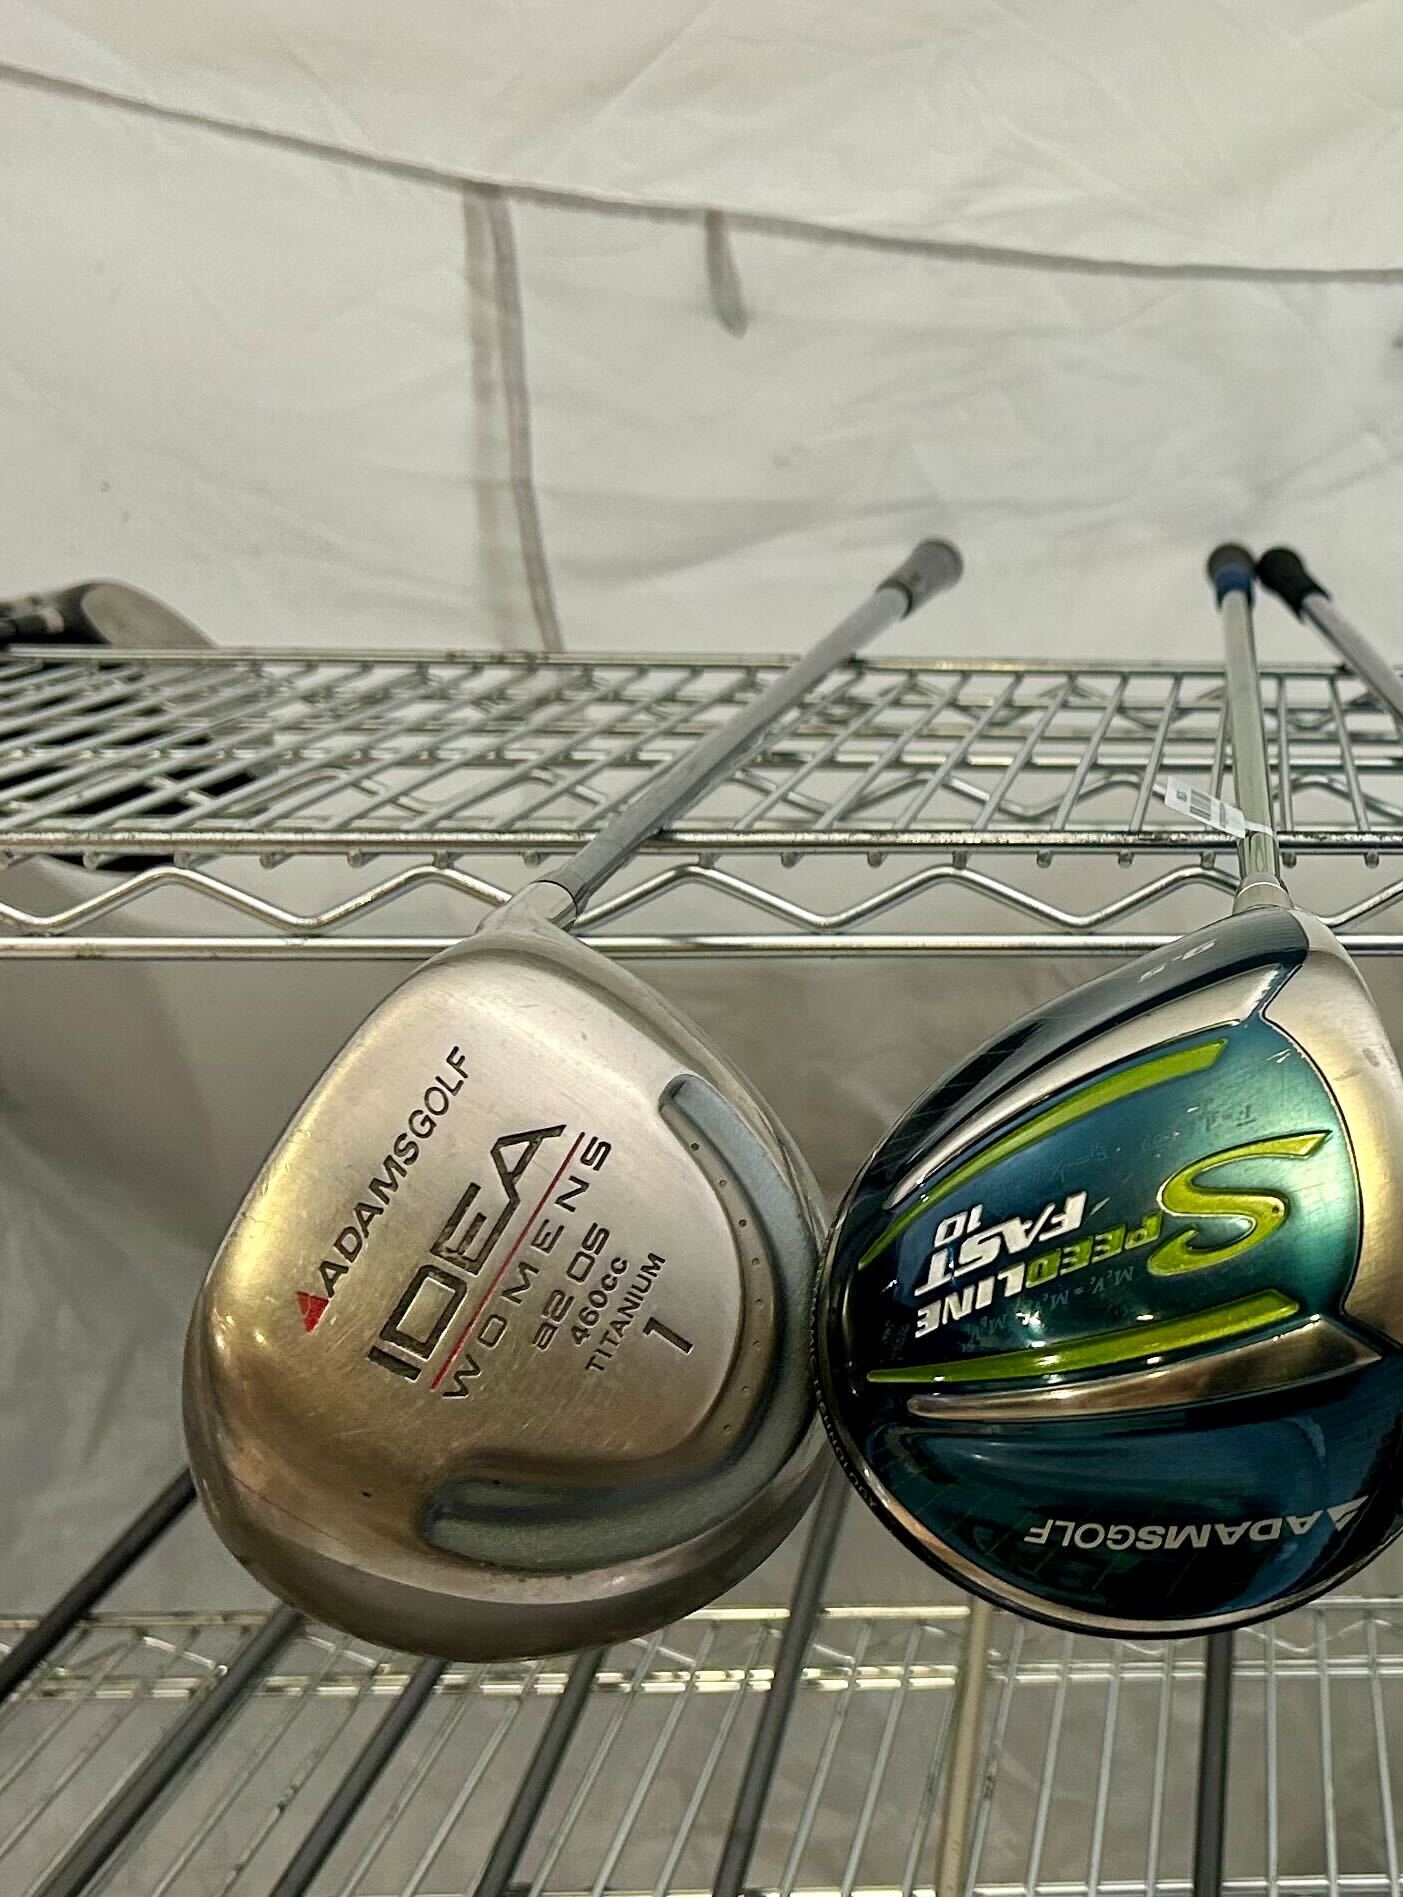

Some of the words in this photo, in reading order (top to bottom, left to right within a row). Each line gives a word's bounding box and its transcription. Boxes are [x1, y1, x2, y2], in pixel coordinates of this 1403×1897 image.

[320, 1046, 471, 1299] ADAMSGOLF
[933, 1203, 984, 1249] 10
[368, 1124, 567, 1380] IDEA
[442, 1136, 612, 1399] WOMENS
[914, 1130, 1333, 1338] SPEEDLINE
[914, 1190, 1088, 1297] FAST
[569, 1256, 630, 1346] 460cc
[584, 1252, 666, 1372] TITANIUM
[642, 1316, 694, 1355] 1
[1025, 1510, 1331, 1552] ADAMSGOLF
